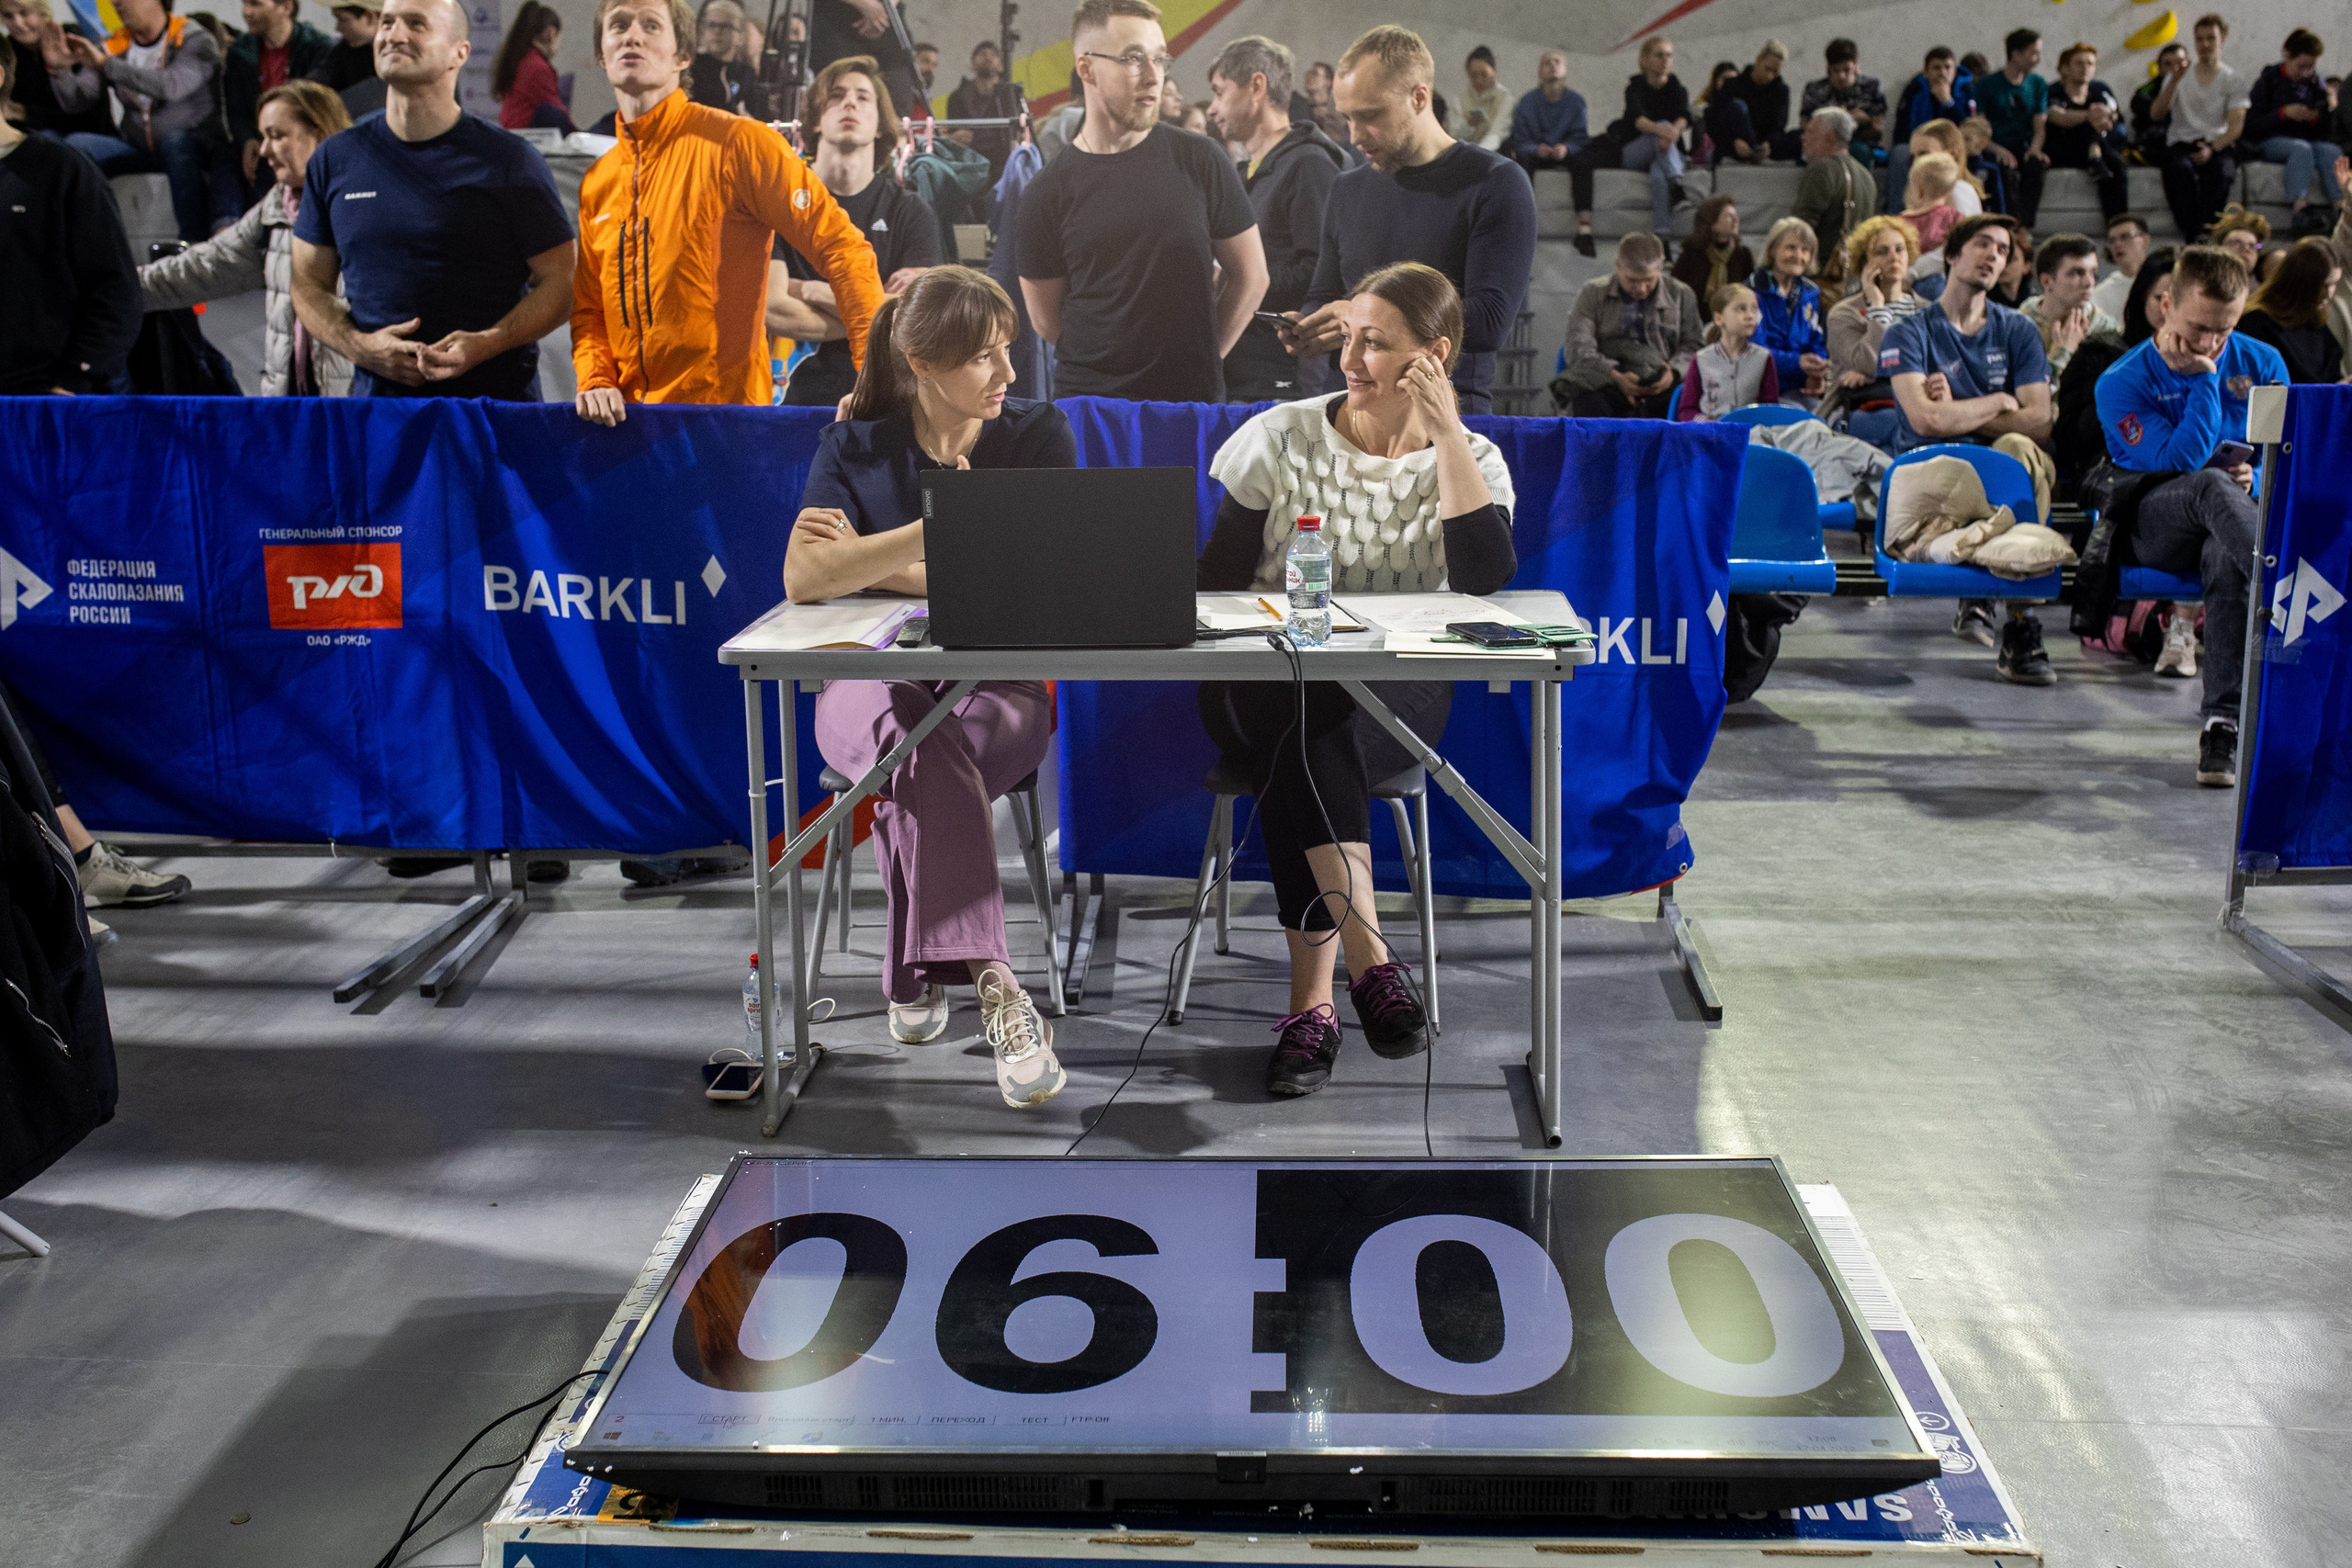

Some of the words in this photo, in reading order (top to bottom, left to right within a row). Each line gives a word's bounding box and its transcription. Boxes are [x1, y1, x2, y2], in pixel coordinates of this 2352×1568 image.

[259, 526, 345, 539] ГЕНЕРАЛЬНЫЙ
[347, 525, 403, 537] СПОНСОР
[67, 559, 156, 578] ФЕДЕРАЦИЯ
[68, 582, 184, 602] СКАЛОЛАЗАНИЯ
[483, 564, 686, 626] BARKLI
[69, 606, 130, 624] РОССИИ
[306, 635, 331, 646] ОАО
[334, 635, 372, 647] «РЖД»
[1599, 616, 1688, 665] KLI
